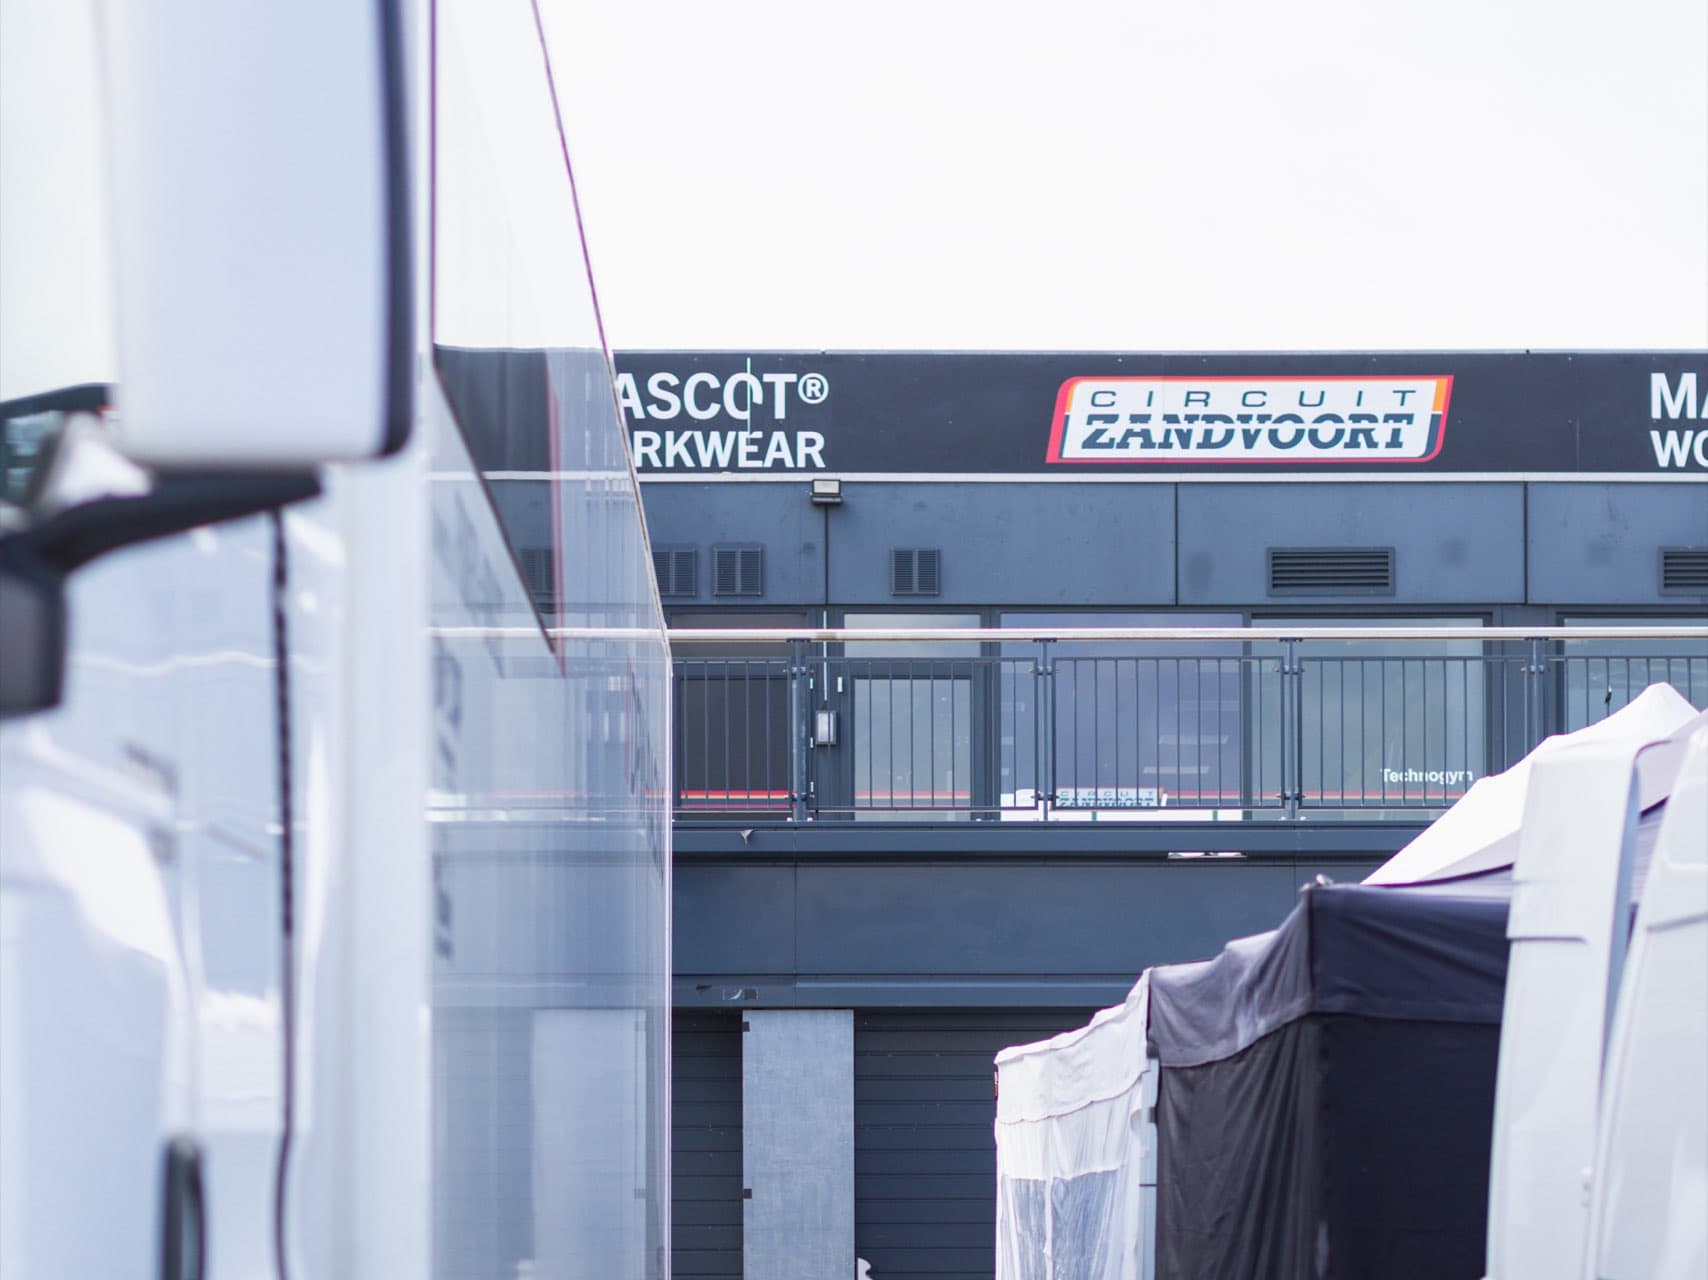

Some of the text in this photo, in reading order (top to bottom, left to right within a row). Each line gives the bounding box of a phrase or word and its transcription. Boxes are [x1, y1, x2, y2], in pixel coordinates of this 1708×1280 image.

[1090, 390, 1416, 407] CIRCUIT
[1650, 372, 1708, 419] M
[633, 430, 826, 468] RKWEAR
[1081, 412, 1415, 449] ZANDVOORT
